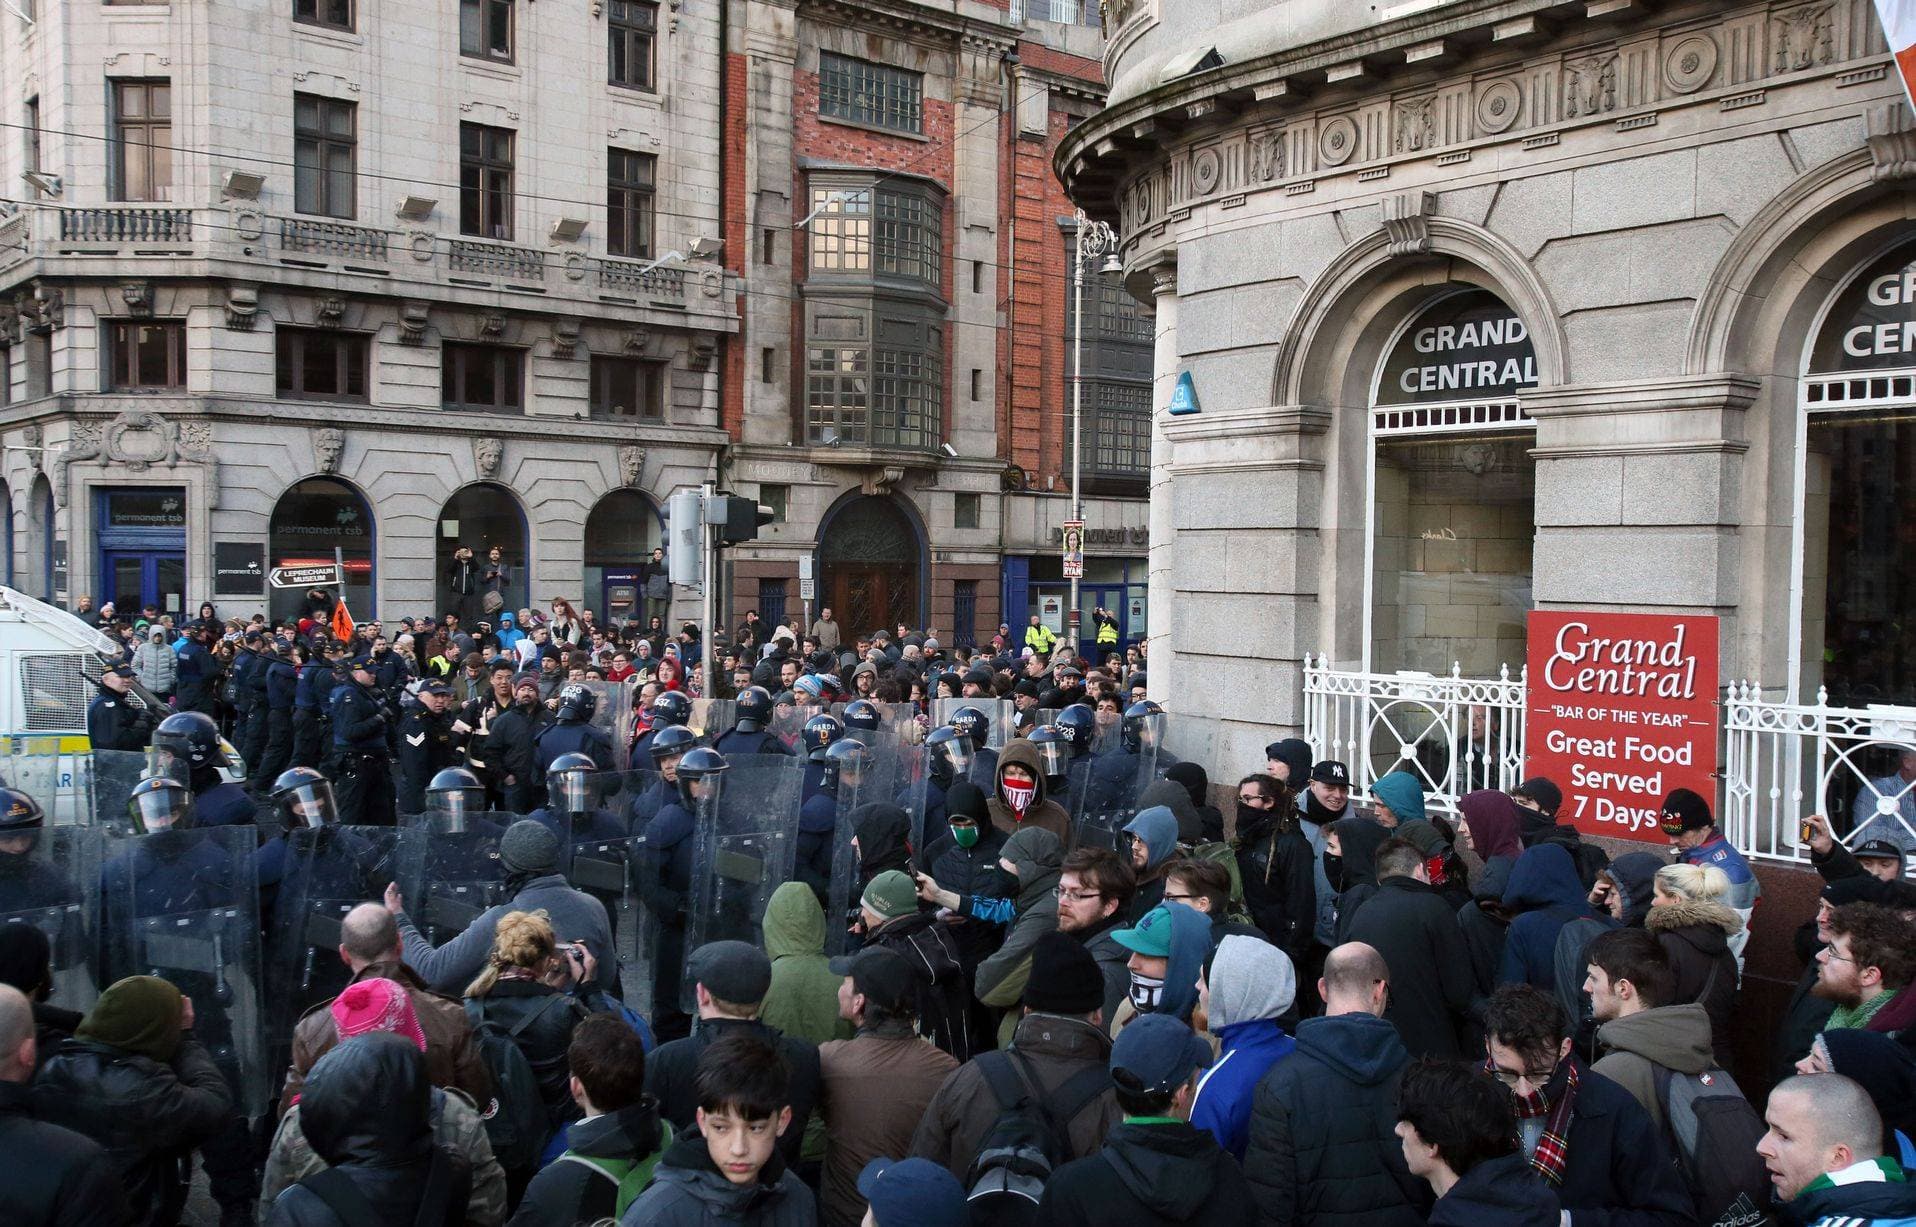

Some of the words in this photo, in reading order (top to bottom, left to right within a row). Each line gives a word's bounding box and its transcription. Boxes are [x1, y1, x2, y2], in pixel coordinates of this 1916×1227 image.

[1414, 317, 1529, 353] GRAND
[1399, 356, 1538, 393] CENTRAL
[114, 514, 166, 522] permanent
[168, 513, 183, 522] tsb
[277, 526, 342, 536] permanent
[344, 524, 363, 536] tsb
[284, 567, 334, 577] LEPRECHAUN
[293, 575, 327, 583] MUSEUM
[1556, 622, 1687, 667] Grand
[1545, 652, 1695, 699] Central
[812, 724, 836, 732] GARDA
[1588, 708, 1607, 721] OF
[1611, 709, 1638, 724] THE
[1546, 730, 1616, 759] Great
[1625, 737, 1692, 766] Food
[1572, 764, 1662, 796] Served
[1573, 796, 1588, 818] 7
[1596, 799, 1657, 831] Days
